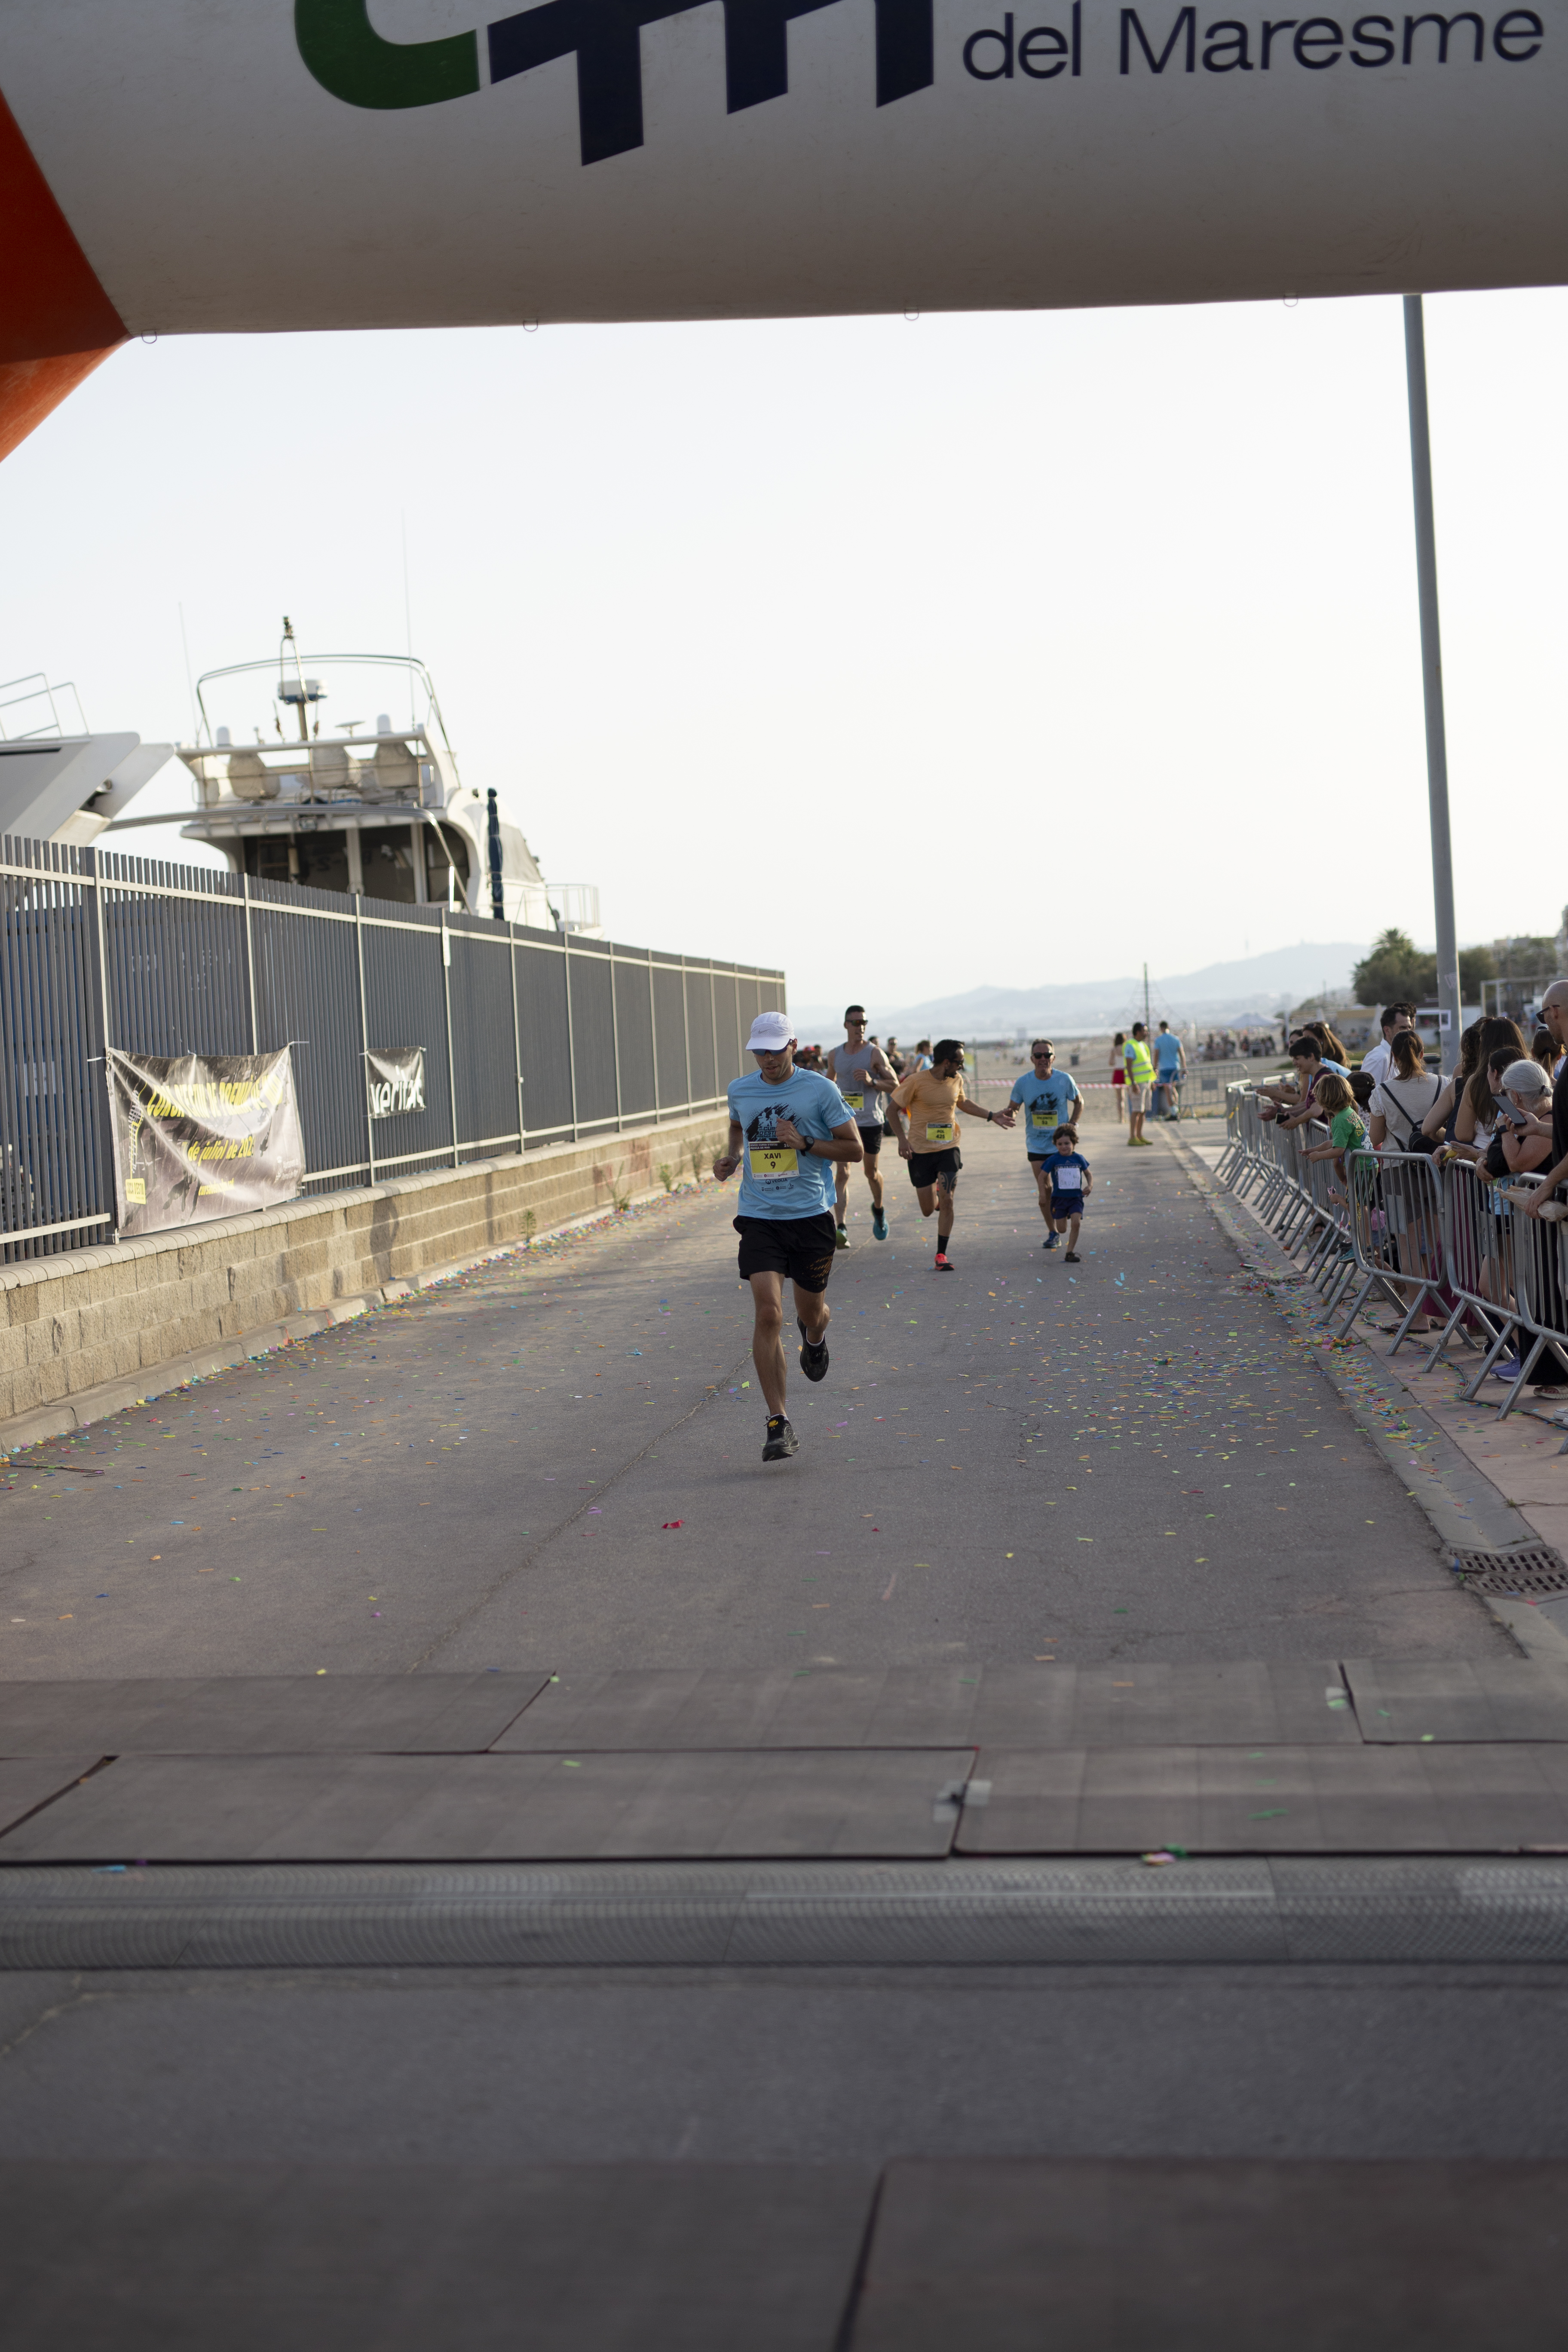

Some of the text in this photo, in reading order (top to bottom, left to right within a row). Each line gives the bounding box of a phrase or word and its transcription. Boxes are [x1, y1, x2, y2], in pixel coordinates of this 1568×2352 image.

[962, 1, 1544, 81] del Maresme
[188, 1141, 200, 1161] de
[198, 1139, 228, 1167] juliol
[226, 1139, 238, 1160] de
